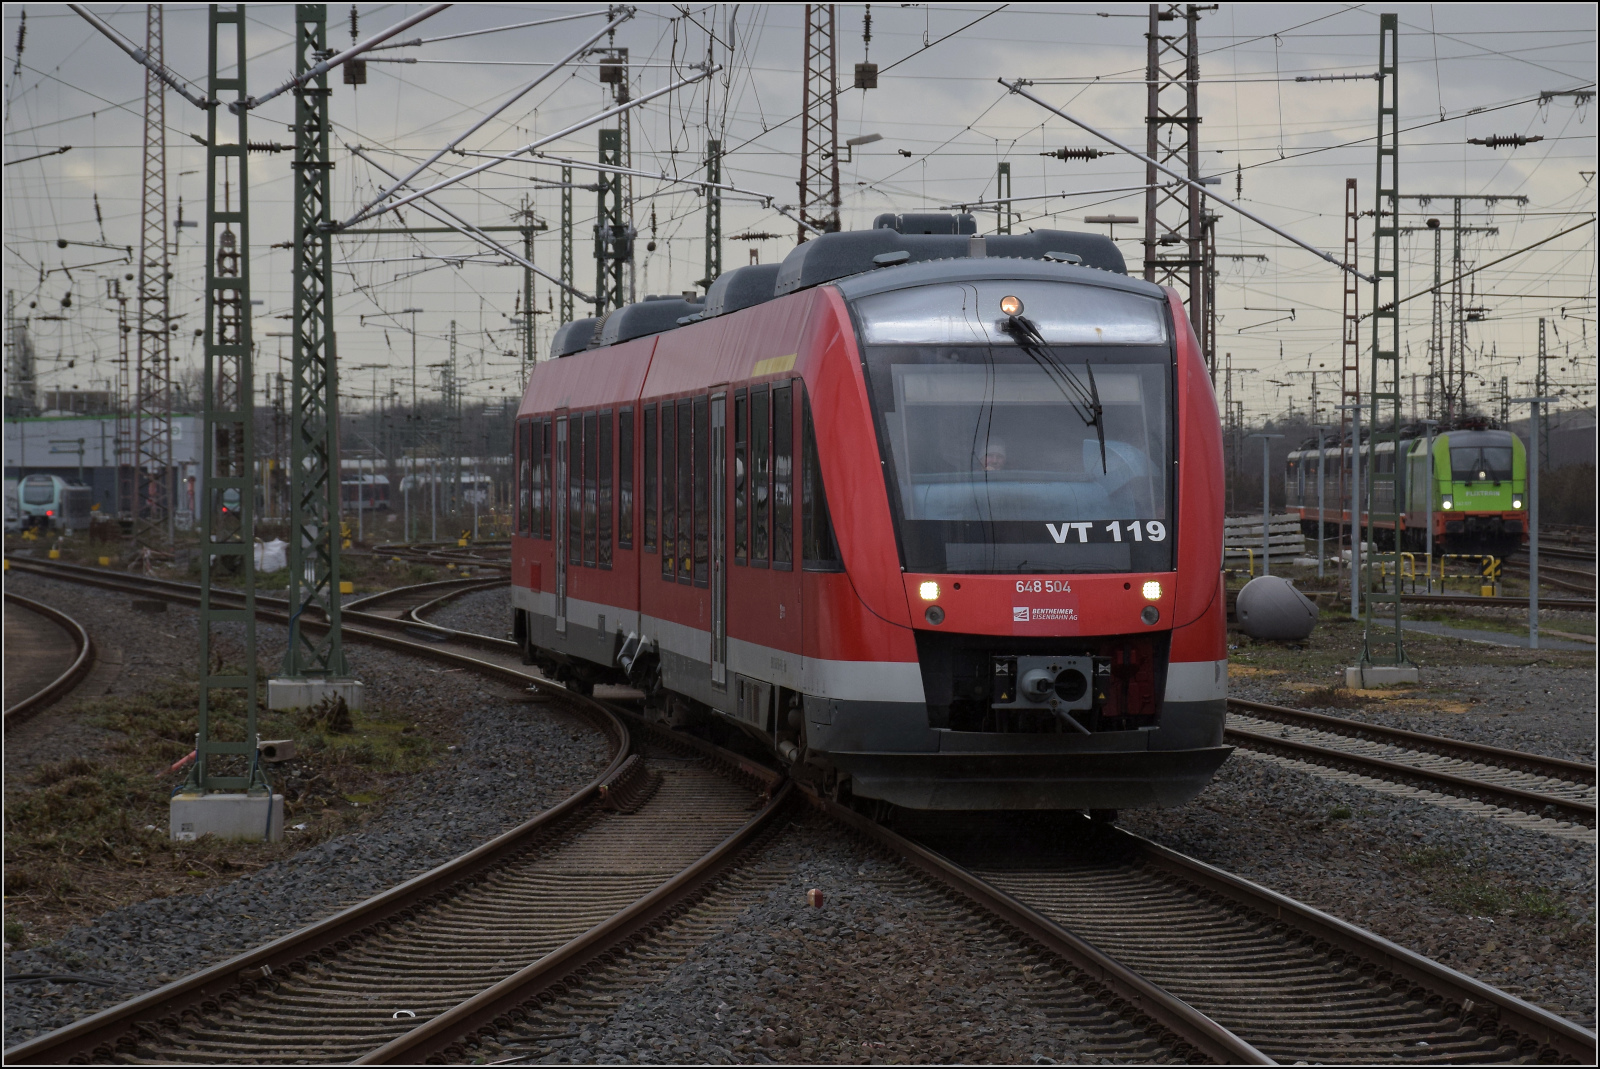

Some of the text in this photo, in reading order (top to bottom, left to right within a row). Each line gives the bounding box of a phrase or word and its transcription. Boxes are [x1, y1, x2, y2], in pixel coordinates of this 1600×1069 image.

[1045, 520, 1167, 544] VT 119
[1016, 580, 1071, 593] 648 504
